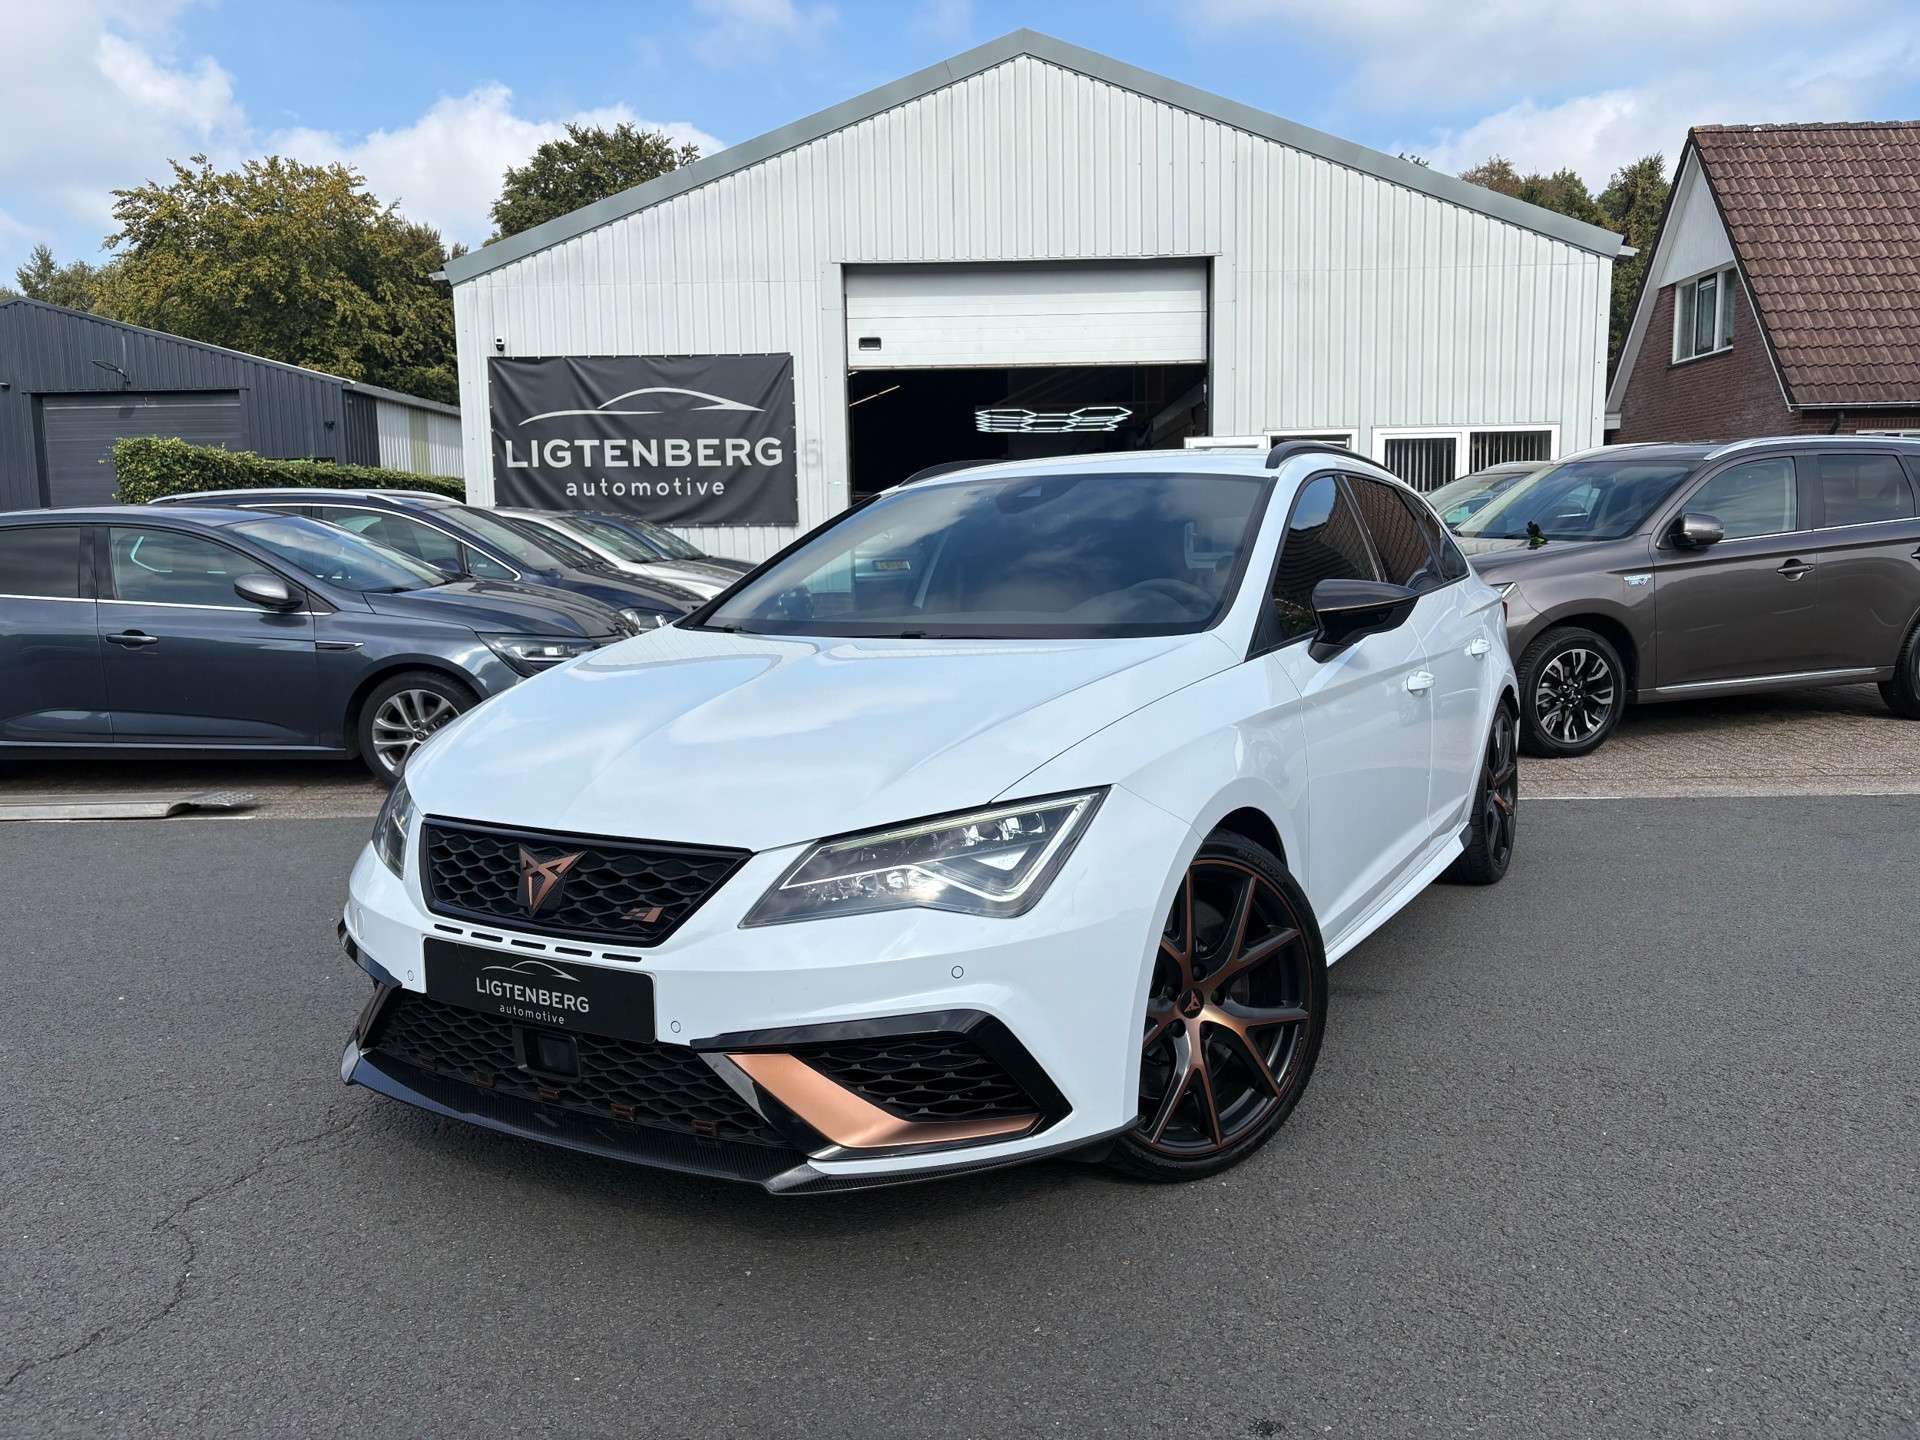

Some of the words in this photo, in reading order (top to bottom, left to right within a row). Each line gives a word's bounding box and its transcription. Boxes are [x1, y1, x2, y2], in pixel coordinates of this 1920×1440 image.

[504, 437, 783, 468] LIGTENBERG
[565, 478, 725, 496] automotive
[476, 977, 590, 1013] LIGTENBERG
[499, 1003, 565, 1025] automotive
